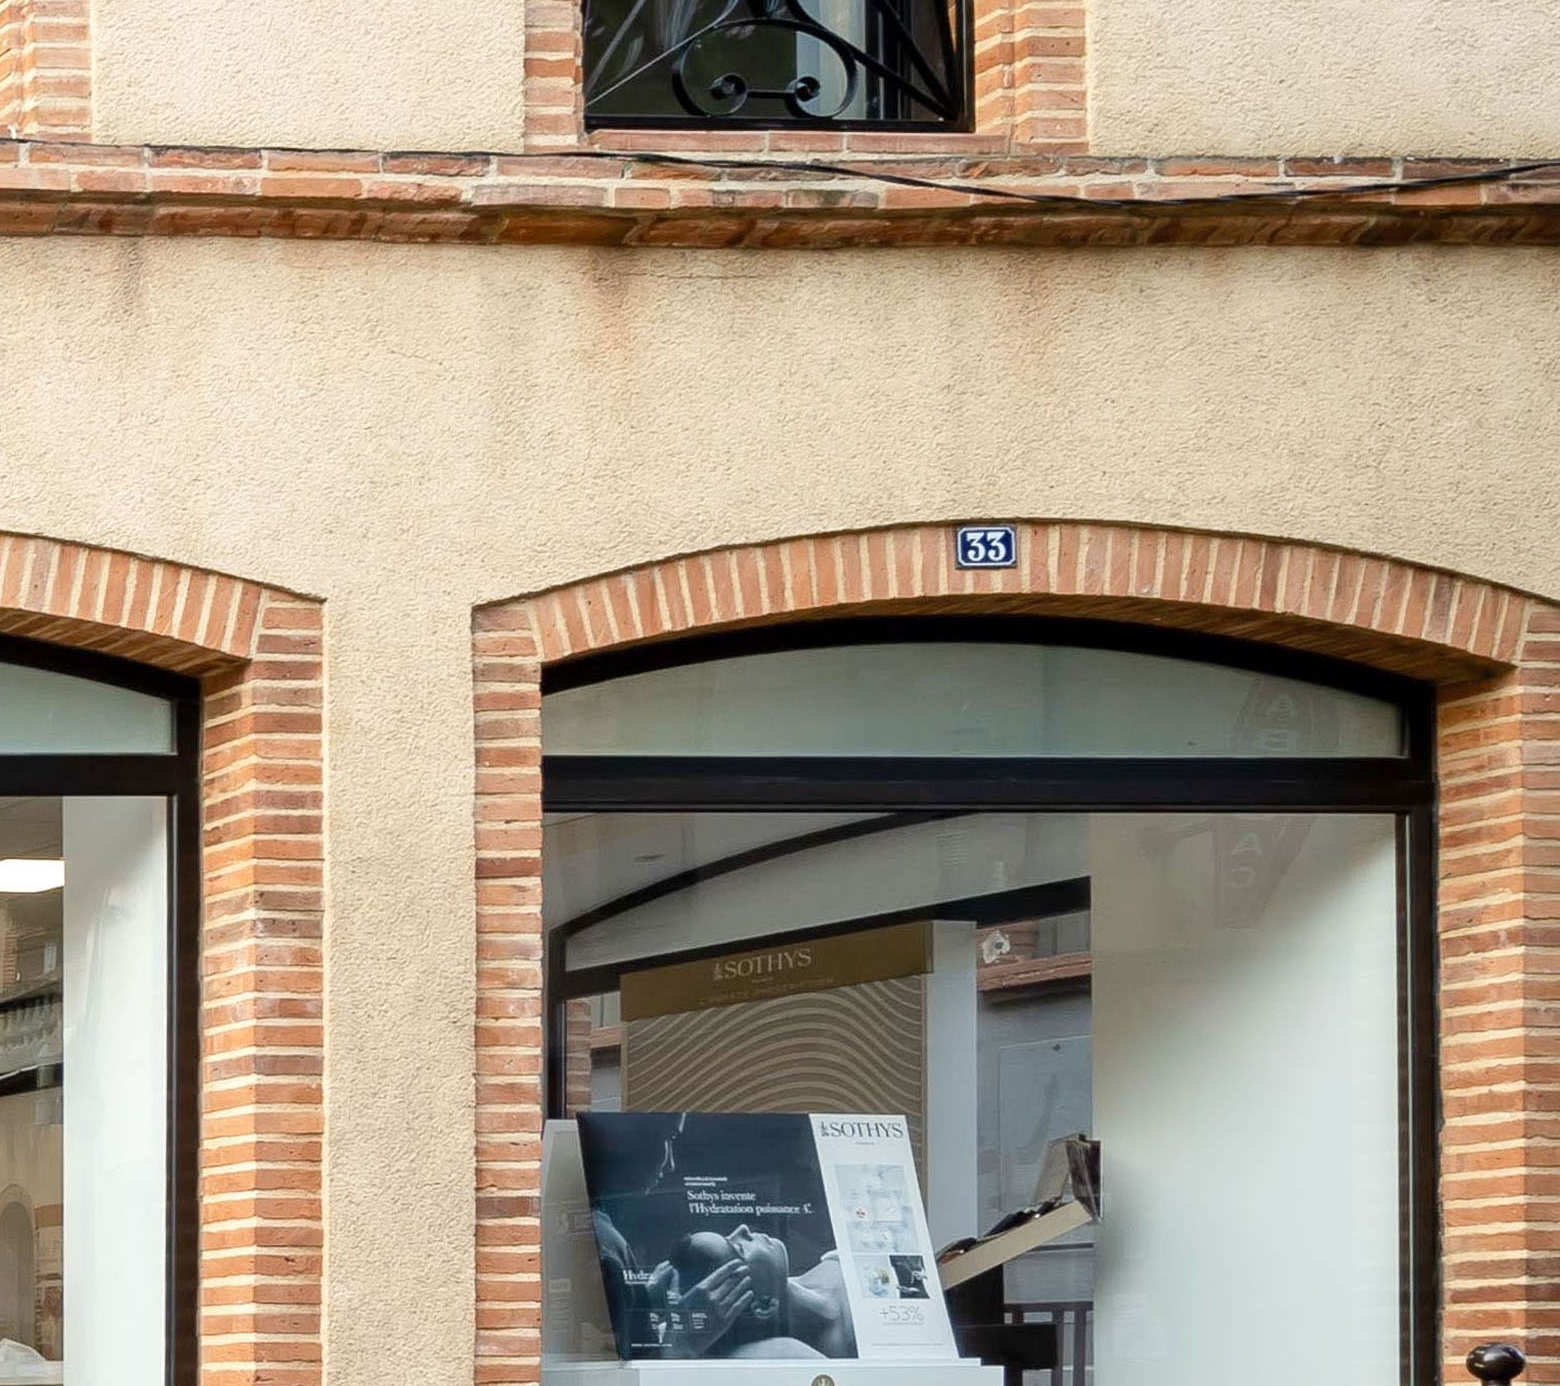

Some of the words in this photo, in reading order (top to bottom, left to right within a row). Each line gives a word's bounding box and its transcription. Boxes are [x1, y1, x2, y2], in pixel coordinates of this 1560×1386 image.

[966, 531, 1006, 562] 33
[724, 948, 812, 980] SOTHYS
[830, 1121, 904, 1139] SOTHYS
[686, 1190, 720, 1202] Sothys
